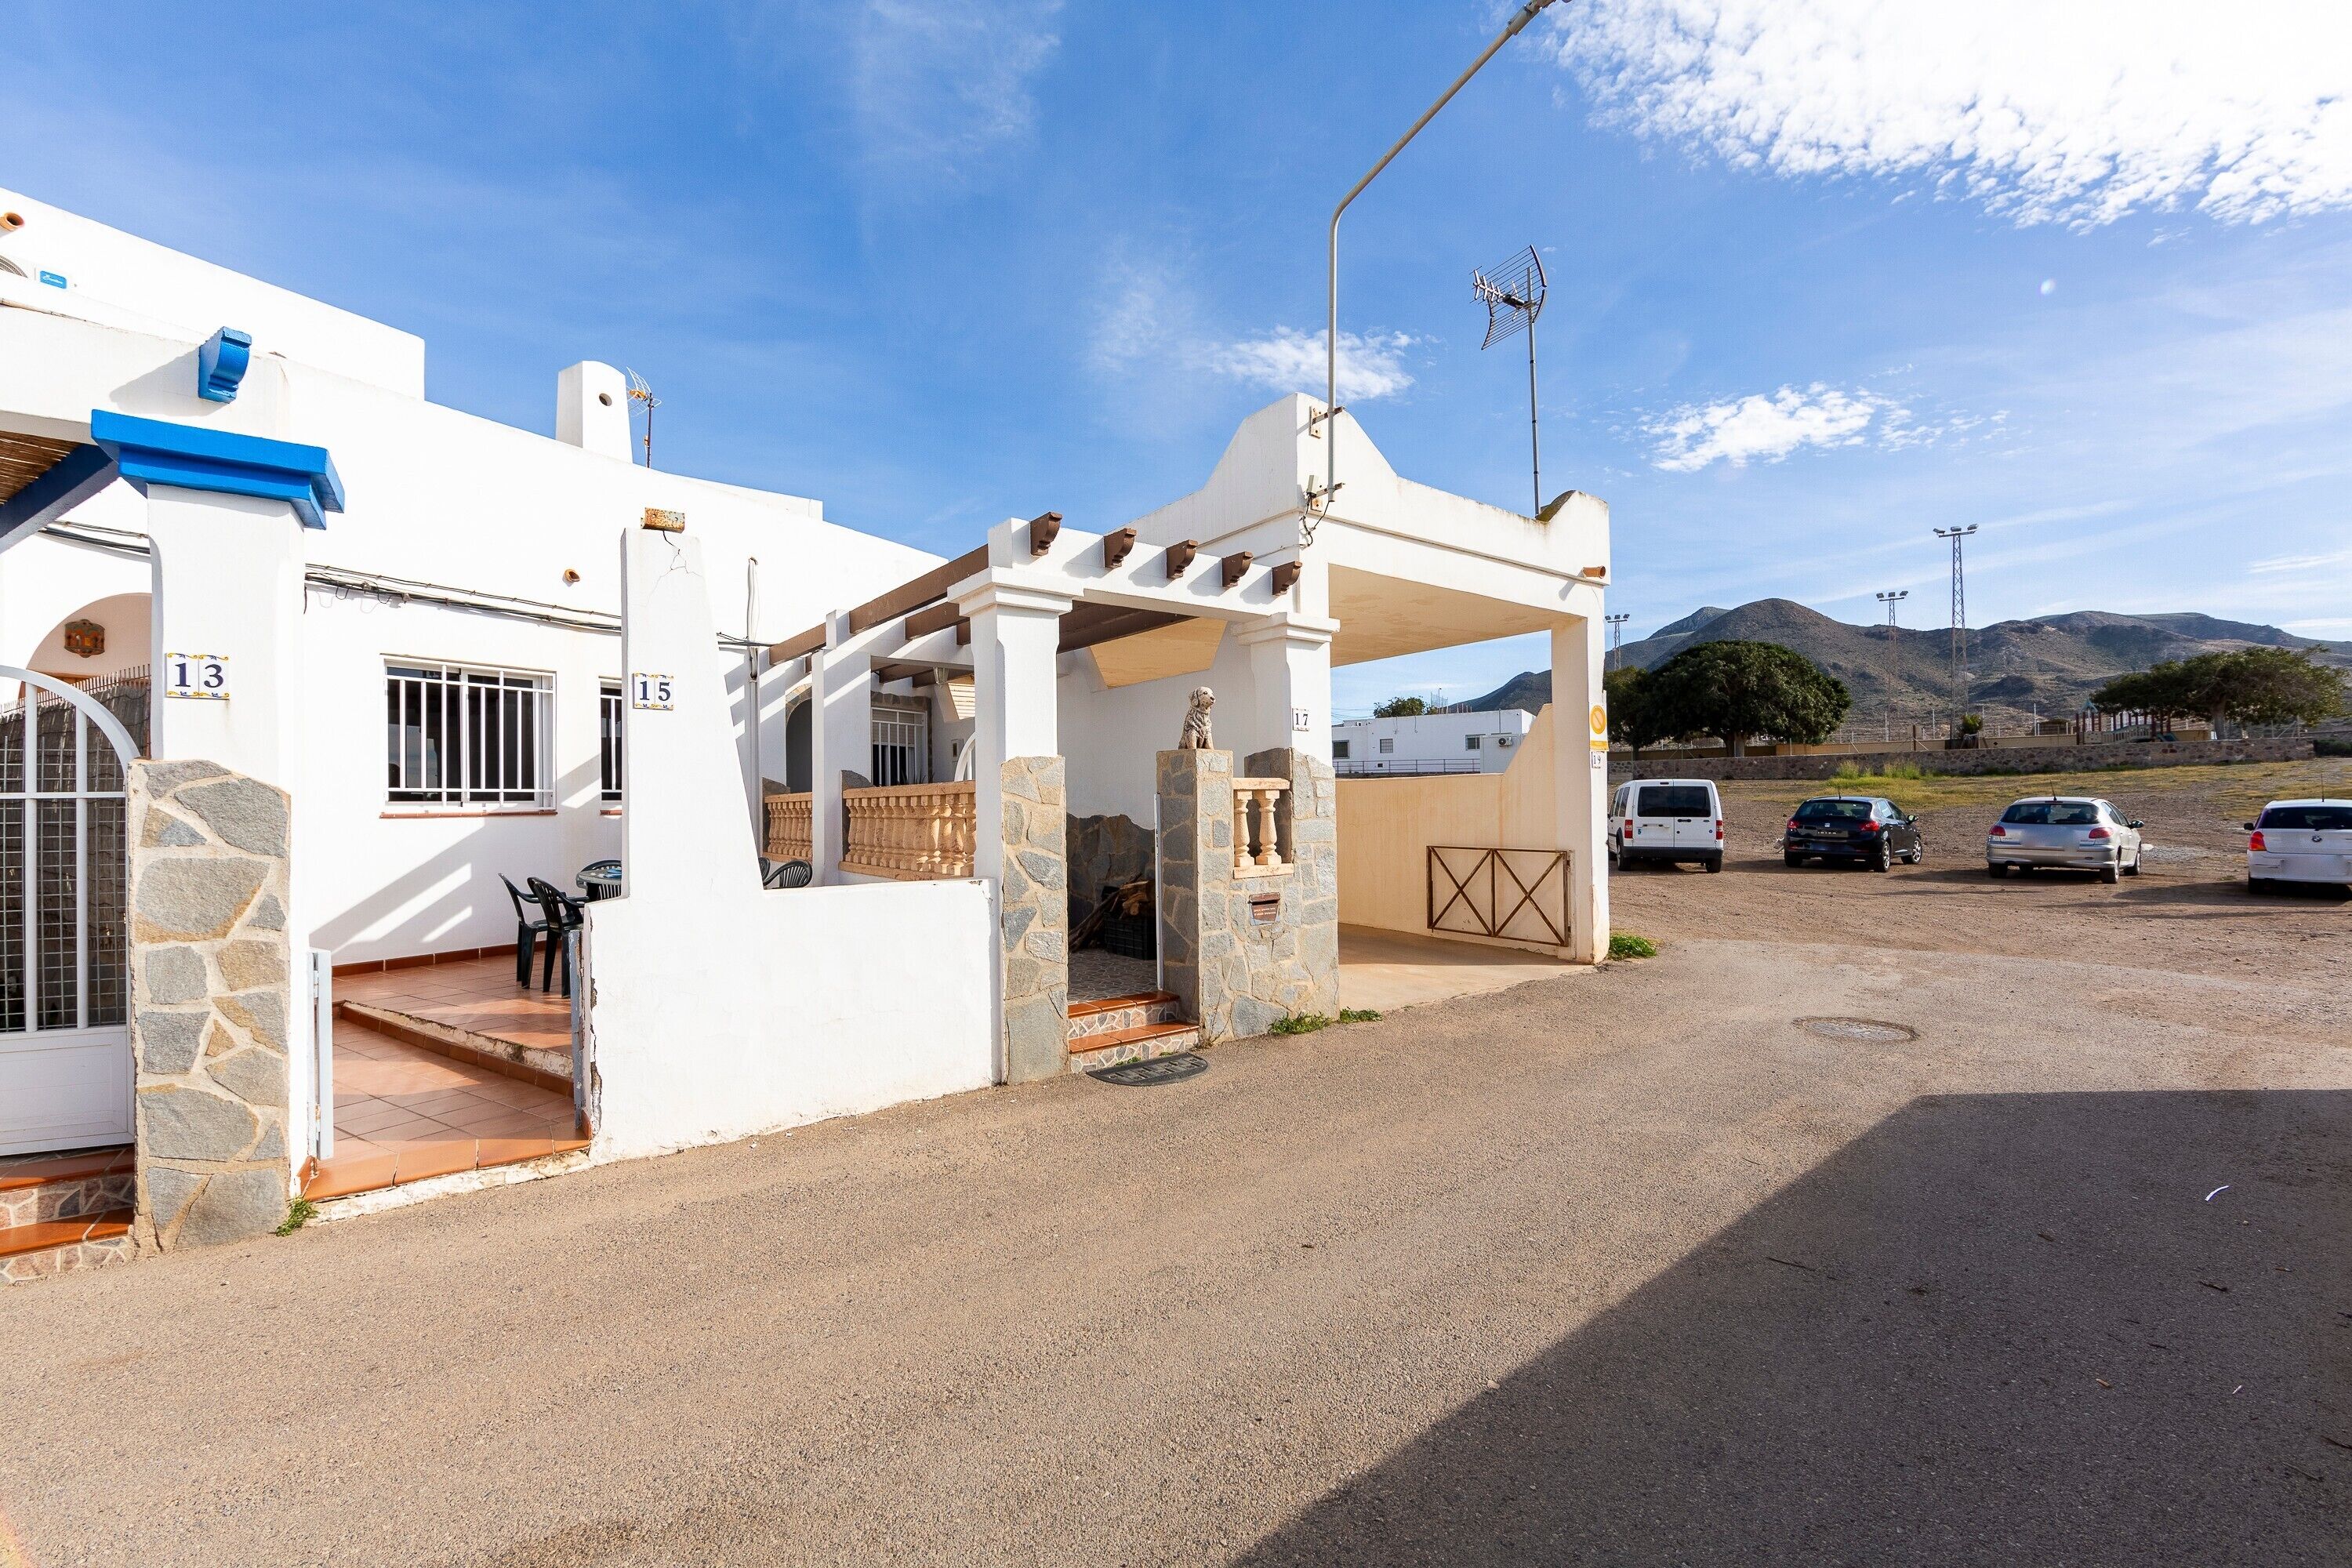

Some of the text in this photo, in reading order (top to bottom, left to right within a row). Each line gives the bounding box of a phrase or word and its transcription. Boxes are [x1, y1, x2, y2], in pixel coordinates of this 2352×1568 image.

[175, 662, 223, 688] 13
[640, 681, 671, 702] 15
[1295, 713, 1308, 726] 17
[1593, 755, 1601, 764] 19
